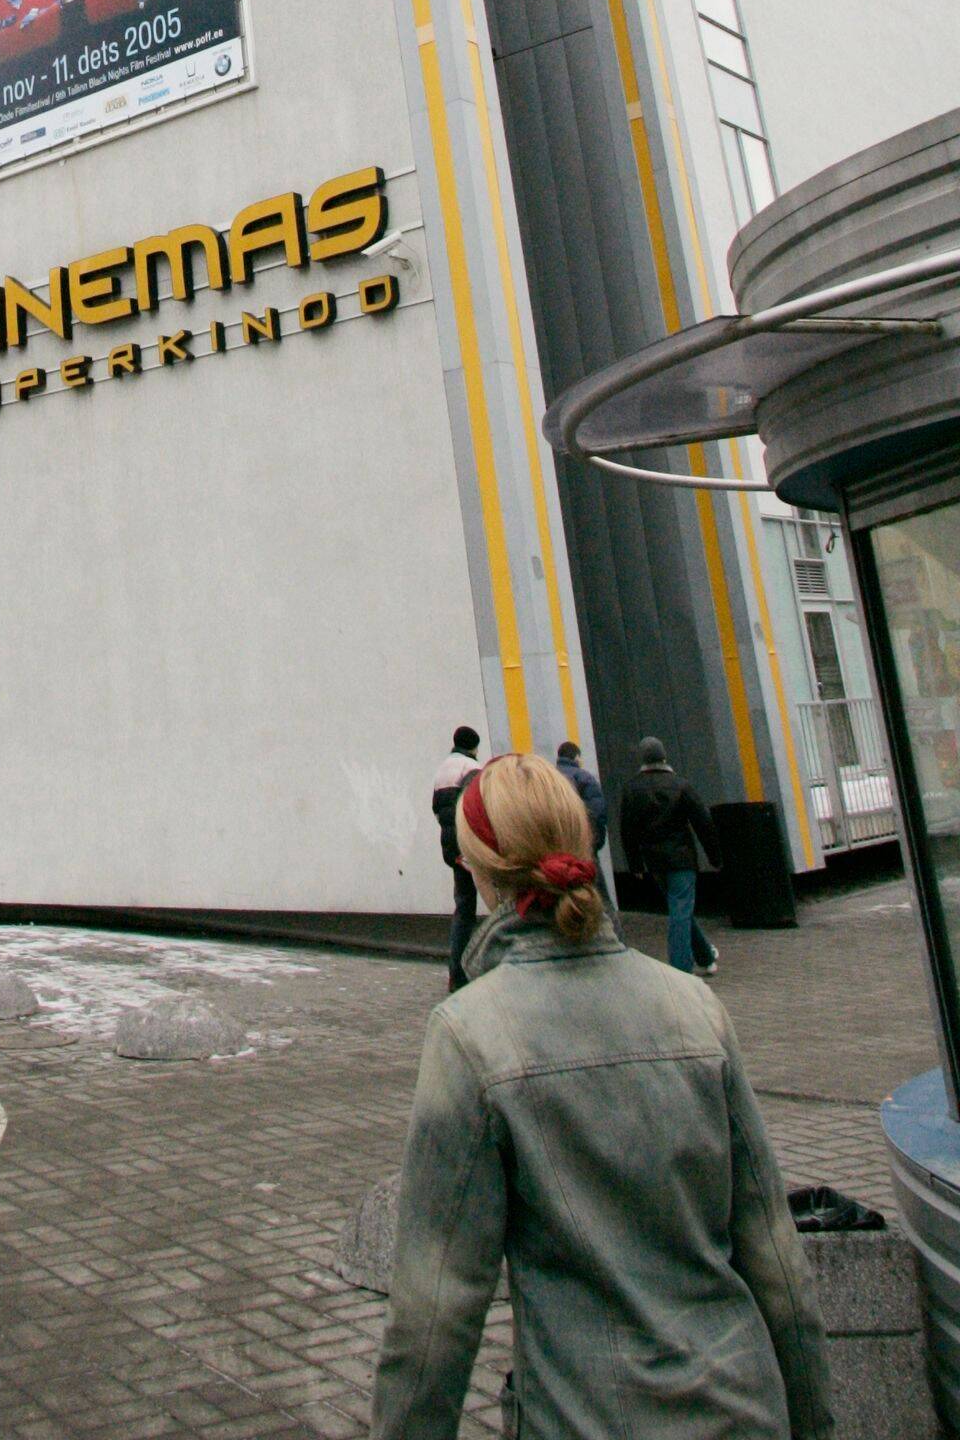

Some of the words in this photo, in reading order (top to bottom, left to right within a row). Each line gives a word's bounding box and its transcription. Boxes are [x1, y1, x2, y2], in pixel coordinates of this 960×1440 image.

[3, 75, 35, 106] nov
[51, 57, 75, 85] 11.
[77, 40, 120, 75] dets
[124, 7, 182, 58] 2005
[88, 73, 107, 89] Black
[107, 63, 129, 82] Nights
[129, 59, 145, 72] Film
[145, 48, 172, 65] Festival
